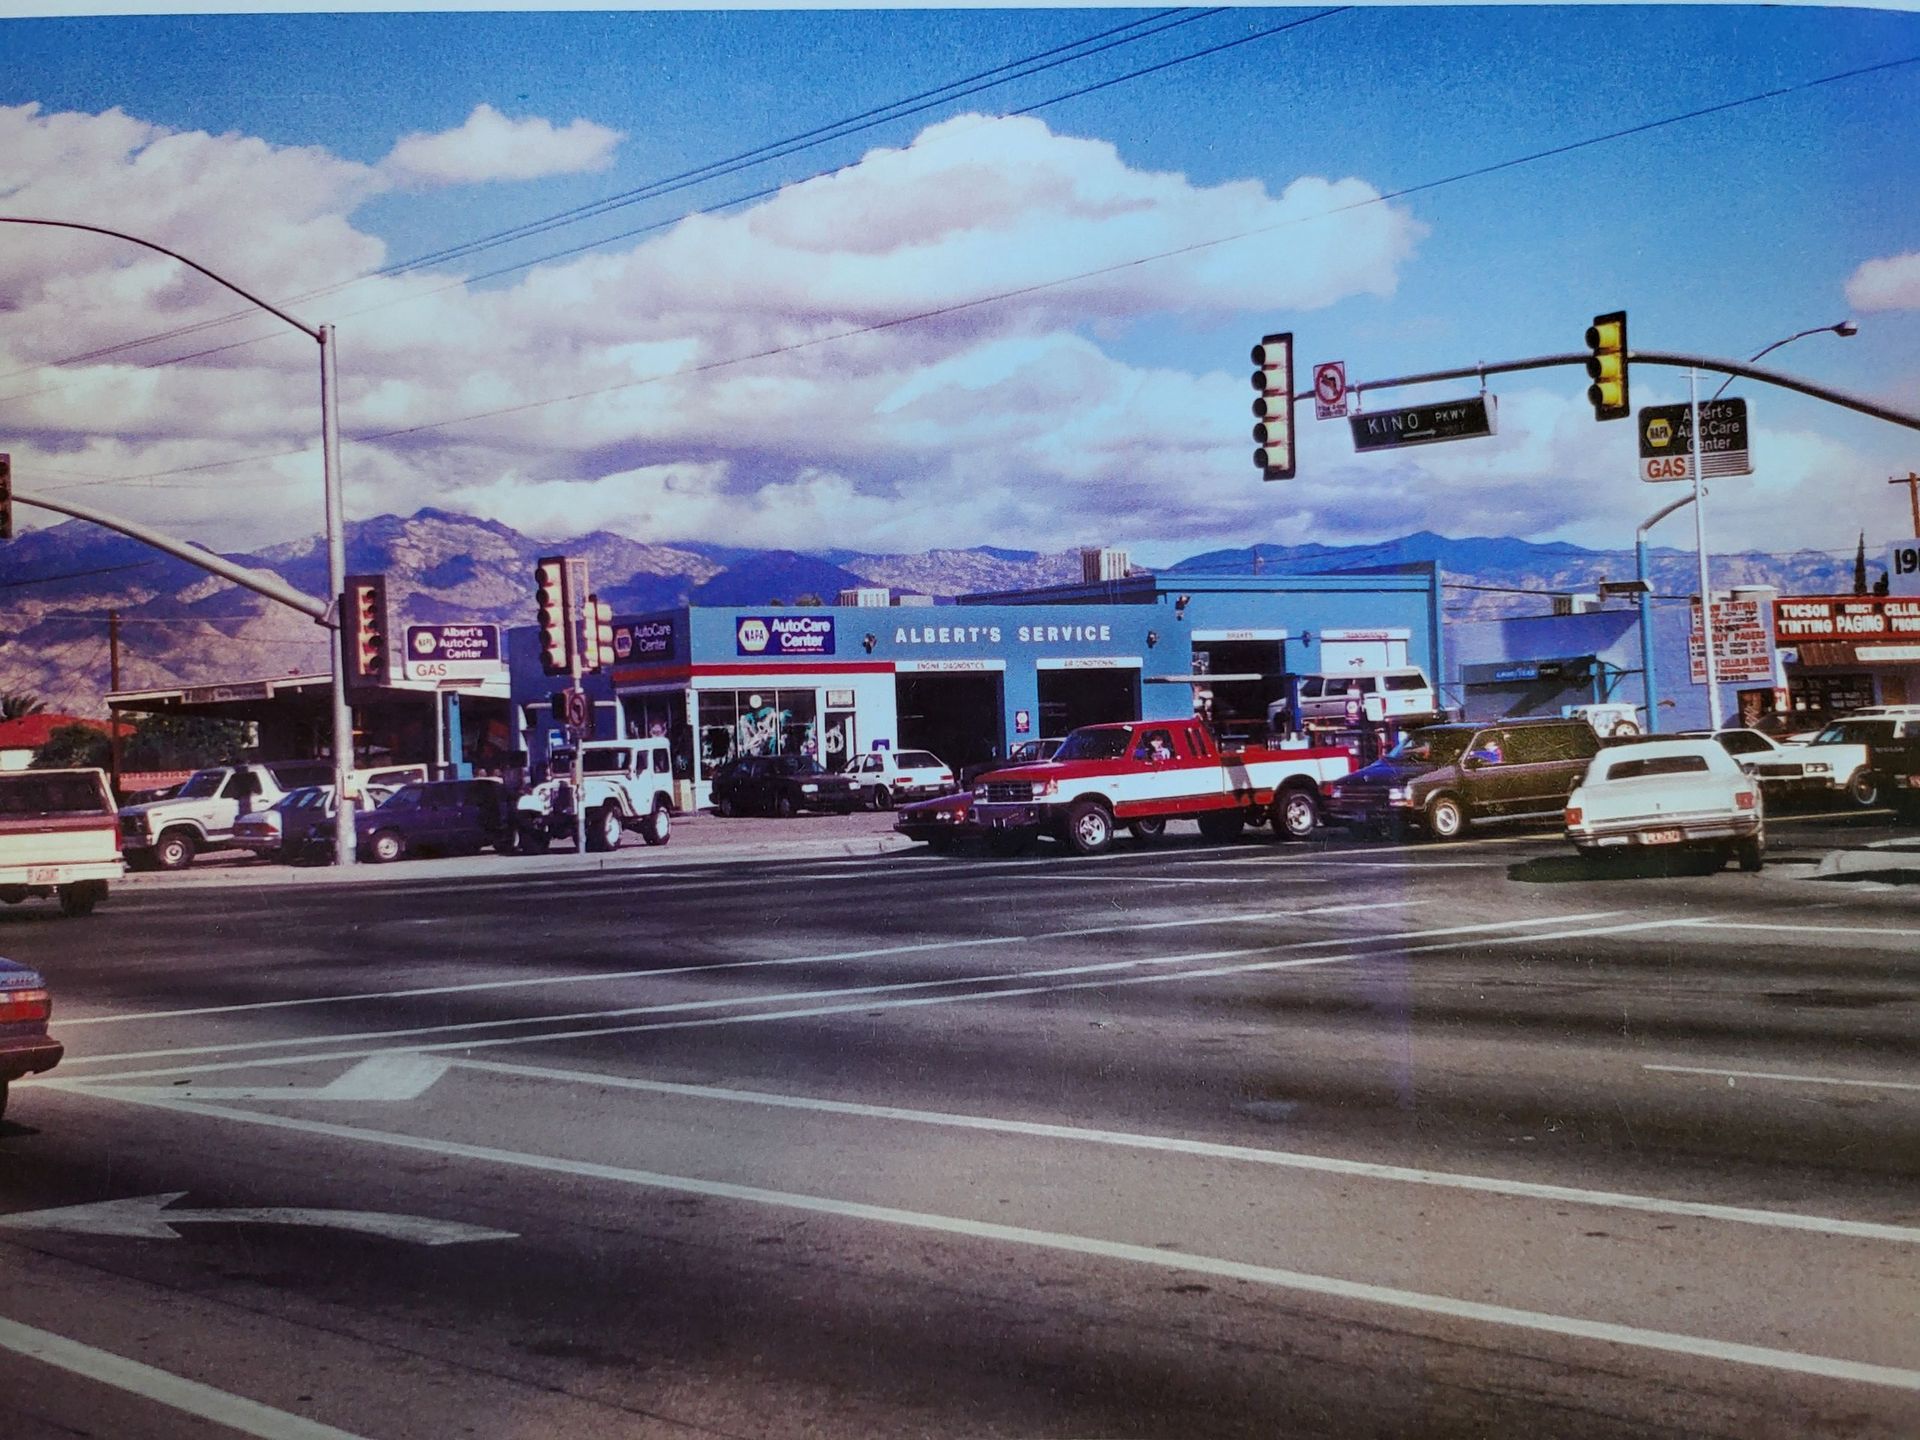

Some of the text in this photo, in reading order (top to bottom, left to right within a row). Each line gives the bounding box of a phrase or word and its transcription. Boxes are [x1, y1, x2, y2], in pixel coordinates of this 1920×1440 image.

[1367, 409, 1466, 435] KINO PKWY
[1677, 420, 1740, 438] AuoCare
[1649, 426, 1669, 440] NAPA
[1647, 457, 1686, 478] GAS
[1894, 548, 1920, 575] 19
[1780, 604, 1829, 617] TUCSON
[634, 623, 672, 638] AutoCare
[771, 618, 831, 632] AutoCare
[1778, 619, 1833, 634] TINTING
[1836, 614, 1884, 633] PAGING
[443, 627, 484, 637] Albert's
[744, 629, 764, 641] NAPA
[894, 625, 1111, 643] ALBERT'S SERVICE
[1734, 631, 1766, 640] PAGERS
[439, 637, 489, 648] AutoCare
[640, 639, 667, 652] Center
[781, 633, 824, 647] Center
[446, 648, 482, 659] Center
[416, 664, 447, 677] GAS
[943, 662, 985, 670] DIAGNOSTICS
